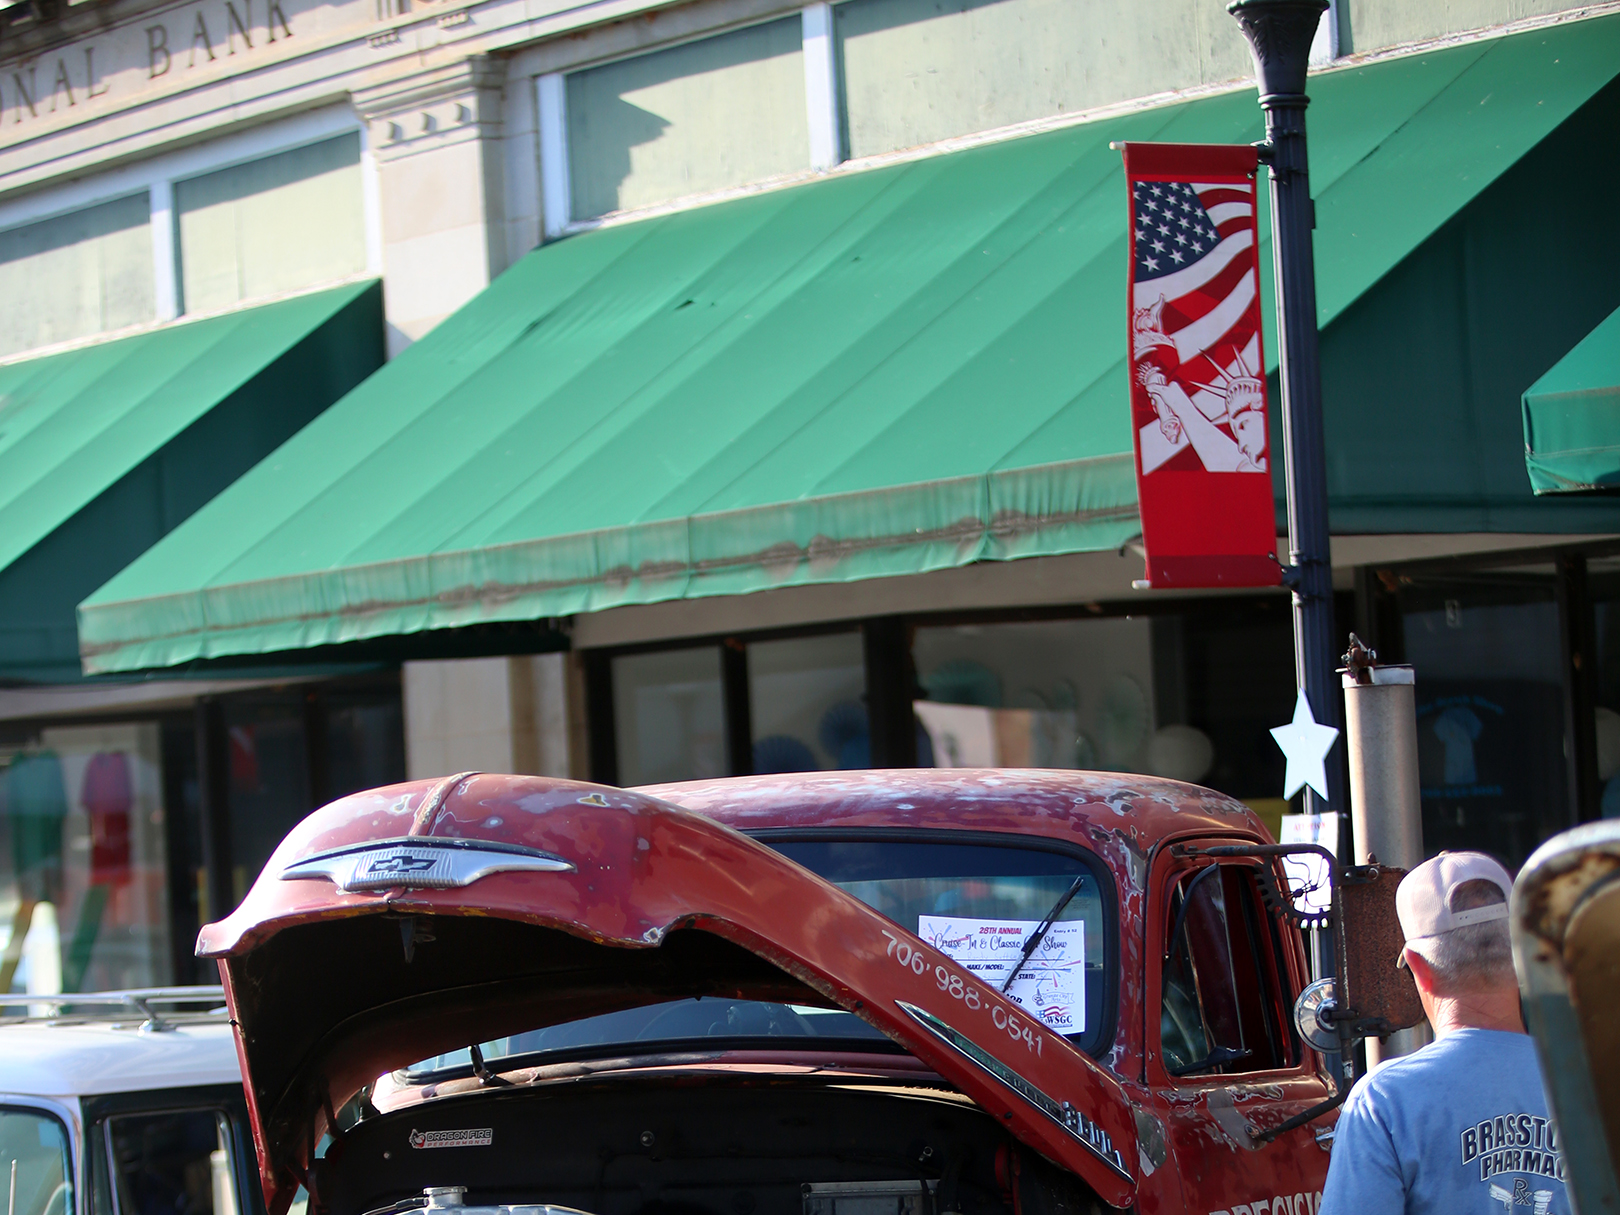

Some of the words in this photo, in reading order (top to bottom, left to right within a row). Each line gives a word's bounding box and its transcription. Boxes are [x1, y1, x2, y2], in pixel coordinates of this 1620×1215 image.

[146, 0, 293, 80] BANK
[979, 926, 997, 935] 28TH
[998, 927, 1023, 935] ANNUAL
[989, 935, 1021, 951] Classic
[1042, 935, 1068, 951] Show
[427, 1131, 468, 1141] DRAGON
[469, 1129, 492, 1139] FIRE
[427, 1139, 491, 1147] PERFORMANCE
